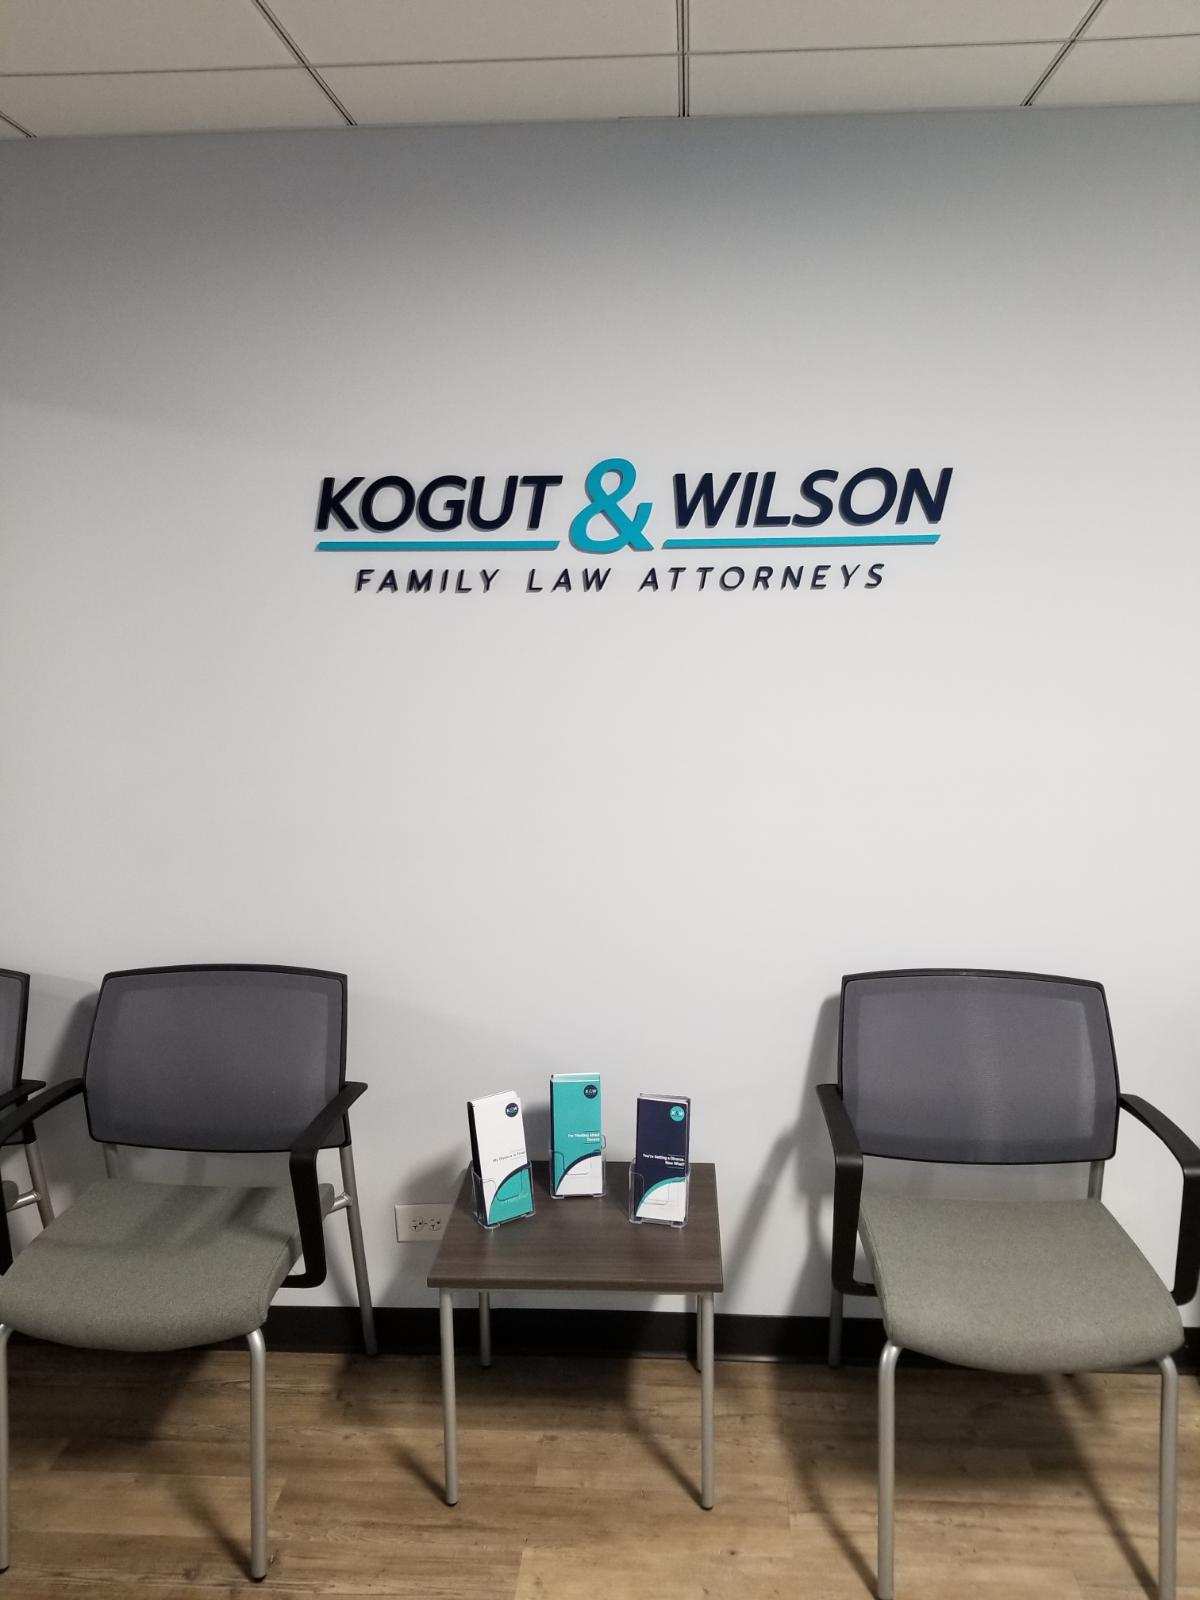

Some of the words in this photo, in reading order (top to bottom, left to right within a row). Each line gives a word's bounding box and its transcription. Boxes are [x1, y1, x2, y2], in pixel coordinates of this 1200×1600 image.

[315, 474, 563, 532] KOGUT
[568, 457, 653, 555] &
[673, 466, 953, 529] WILSON
[354, 567, 499, 593] FAMILY
[525, 567, 611, 593] LAW
[638, 562, 885, 592] ATTORNEYS
